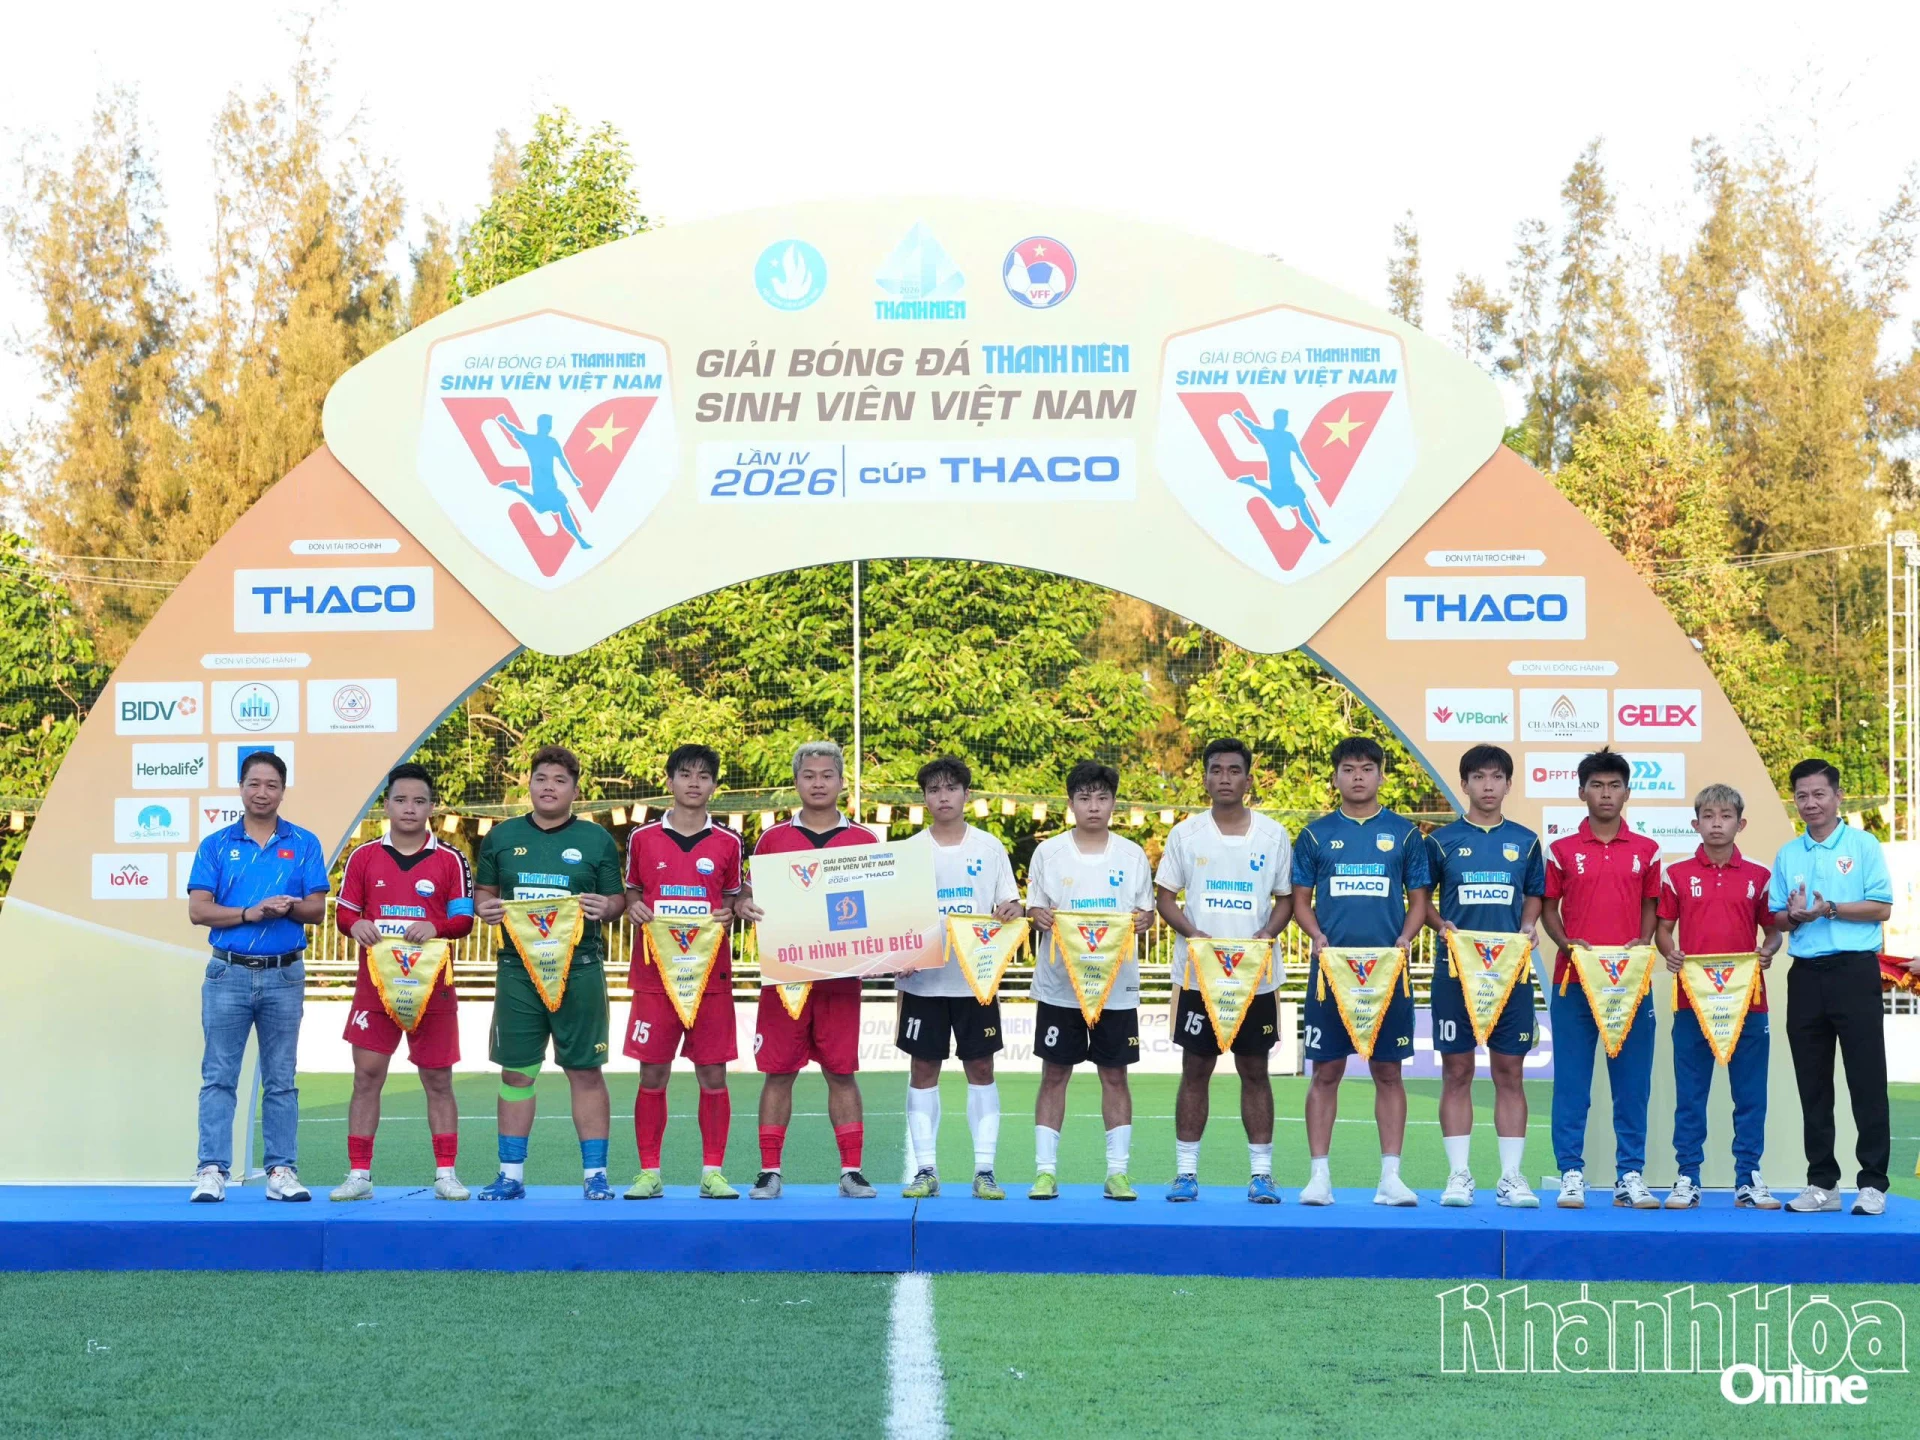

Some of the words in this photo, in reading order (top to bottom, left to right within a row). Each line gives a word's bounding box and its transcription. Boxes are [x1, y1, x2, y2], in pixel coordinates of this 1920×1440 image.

[1030, 290, 1051, 299] VFF
[695, 339, 776, 378] GIẢI
[788, 340, 905, 378] BÓNG
[915, 339, 971, 377] ĐÁ
[440, 375, 493, 391] SINH
[500, 371, 550, 391] VIÊN
[558, 371, 608, 393] VIỆT
[612, 375, 662, 390] NAM
[1176, 370, 1230, 385] SINH
[1236, 366, 1287, 385] VIÊN
[1293, 366, 1343, 388] VIỆT
[1348, 369, 1397, 384] NAM
[695, 391, 802, 422] SINH
[816, 384, 916, 421] VIÊN
[931, 384, 1022, 428] VIỆT
[1032, 389, 1137, 420] NAM
[736, 448, 786, 466] LẦN
[788, 451, 811, 466] IV
[859, 461, 927, 485] CÚP
[939, 456, 1120, 484] THACO
[710, 467, 838, 497] 2026
[252, 584, 416, 614] THACO
[1403, 593, 1568, 622] THACO
[121, 700, 177, 721] BIDV
[242, 706, 268, 718] NTU
[1456, 711, 1508, 724] VPBank
[1618, 704, 1697, 727] GELEX
[1528, 721, 1564, 730] CHAMPA
[1566, 720, 1600, 729] ISLAND
[137, 763, 198, 776] Herbalife
[1549, 770, 1569, 780] FPT
[1629, 781, 1675, 791] ULBAL
[864, 871, 895, 879] THACO
[1577, 862, 1585, 874] 3
[111, 871, 149, 886] laVie
[1335, 881, 1384, 891] THACO
[1463, 889, 1509, 899] THACO
[1690, 885, 1702, 898] 10
[659, 905, 708, 915] THACO
[938, 904, 973, 915] HACO
[1205, 898, 1252, 910] THACO
[379, 924, 406, 934] THA
[777, 943, 803, 964] ĐỘI
[808, 940, 847, 960] HÌNH
[852, 936, 884, 956] TIÊU
[889, 928, 923, 952] BIỂU
[351, 1010, 369, 1031] 14
[905, 1016, 922, 1041] 11
[1184, 1011, 1205, 1036] 15
[631, 1019, 652, 1044] 15
[1045, 1026, 1060, 1047] 8
[1305, 1025, 1322, 1050] 12
[1438, 1019, 1456, 1042] 10
